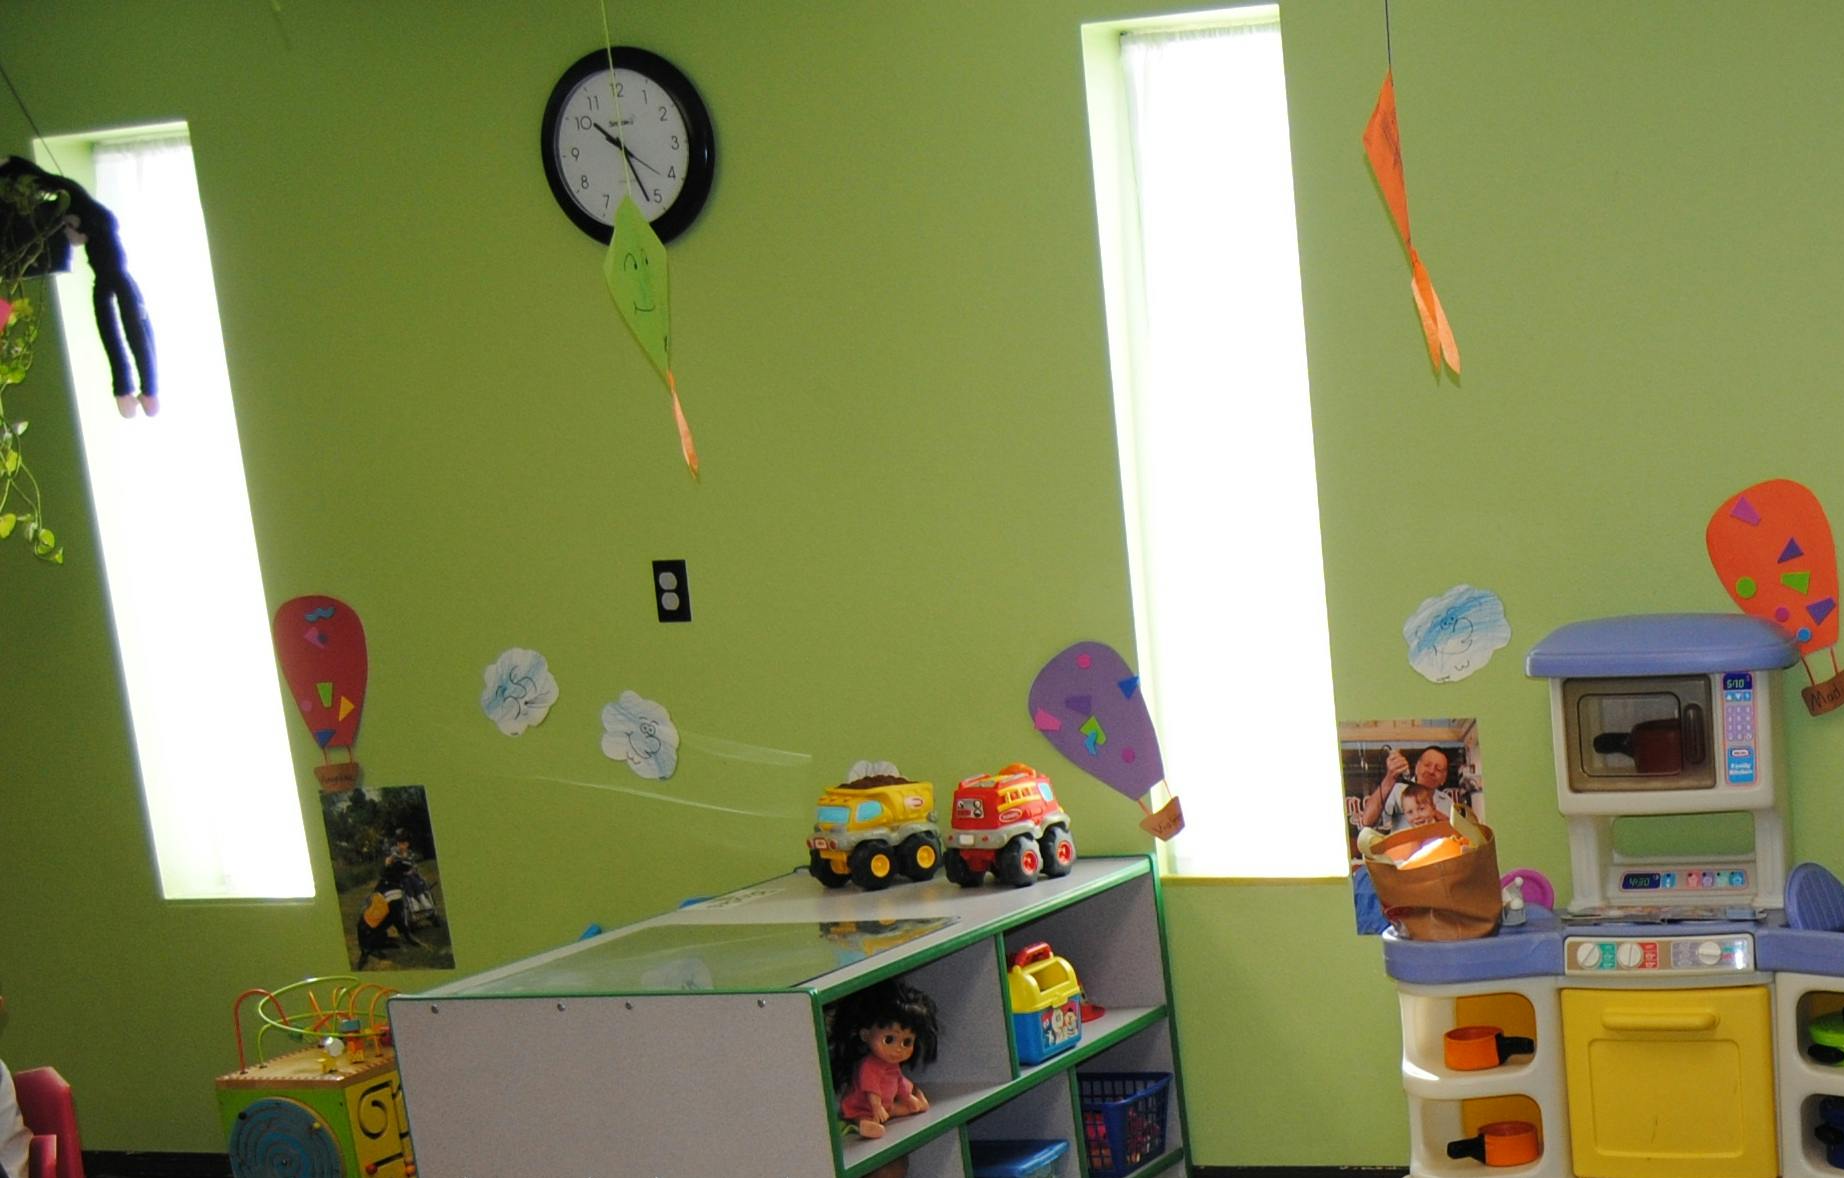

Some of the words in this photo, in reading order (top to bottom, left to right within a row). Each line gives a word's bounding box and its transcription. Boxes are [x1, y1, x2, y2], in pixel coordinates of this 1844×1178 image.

[610, 82, 624, 98] 12
[642, 89, 648, 104] 1
[587, 95, 600, 110] 11
[659, 105, 668, 121] 2
[575, 115, 592, 131] 10
[671, 135, 680, 150] 3
[571, 147, 580, 161] 9
[667, 166, 676, 181] 4
[580, 174, 589, 190] 8
[602, 194, 610, 209] 7
[653, 189, 663, 204] 5
